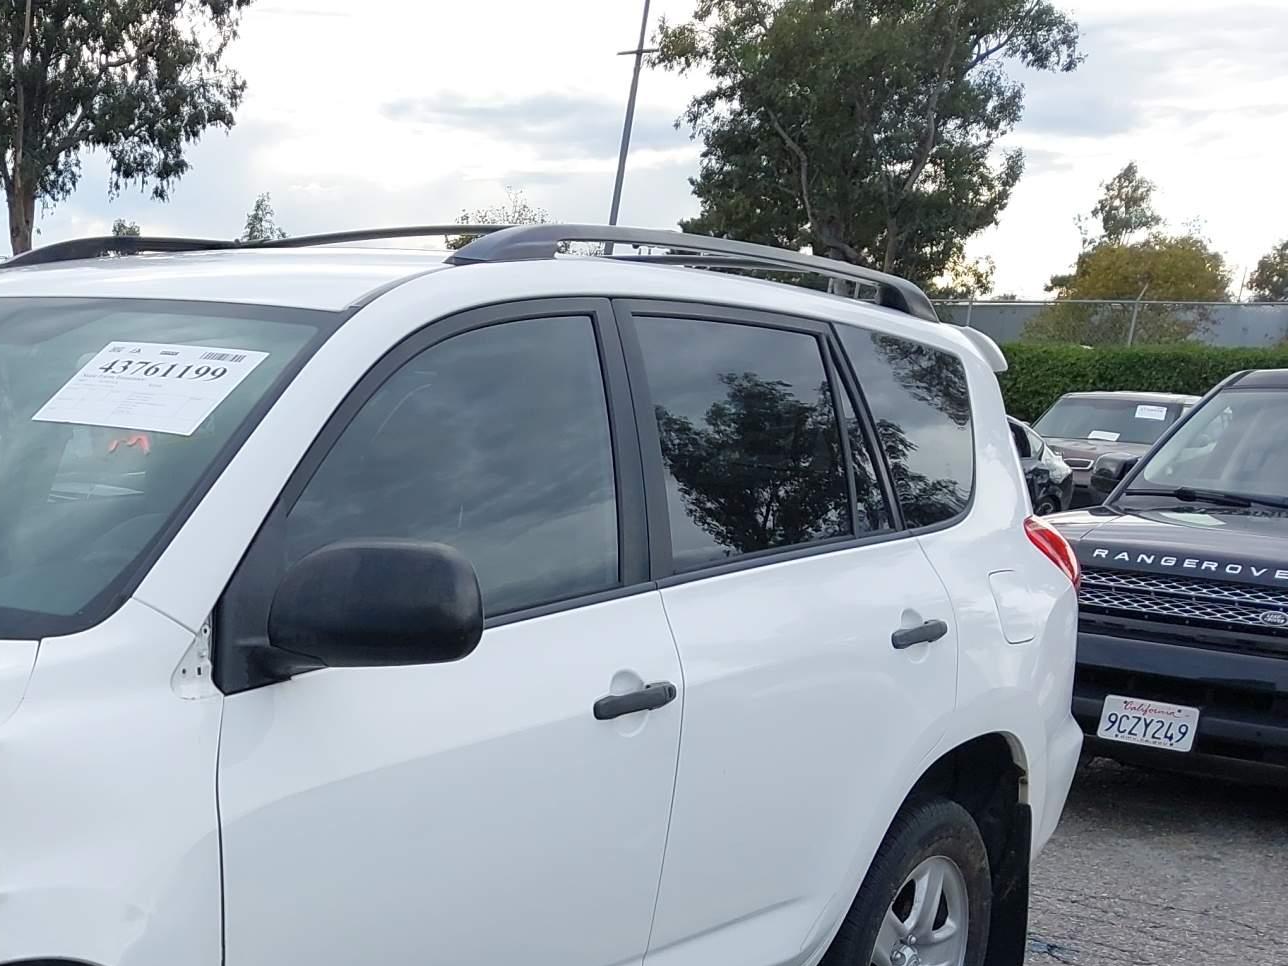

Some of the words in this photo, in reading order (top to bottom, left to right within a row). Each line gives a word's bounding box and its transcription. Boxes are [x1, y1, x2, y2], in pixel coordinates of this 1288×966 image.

[98, 359, 228, 383] 43761199
[1123, 700, 1183, 718] California
[1104, 712, 1189, 743] 9CZY249
